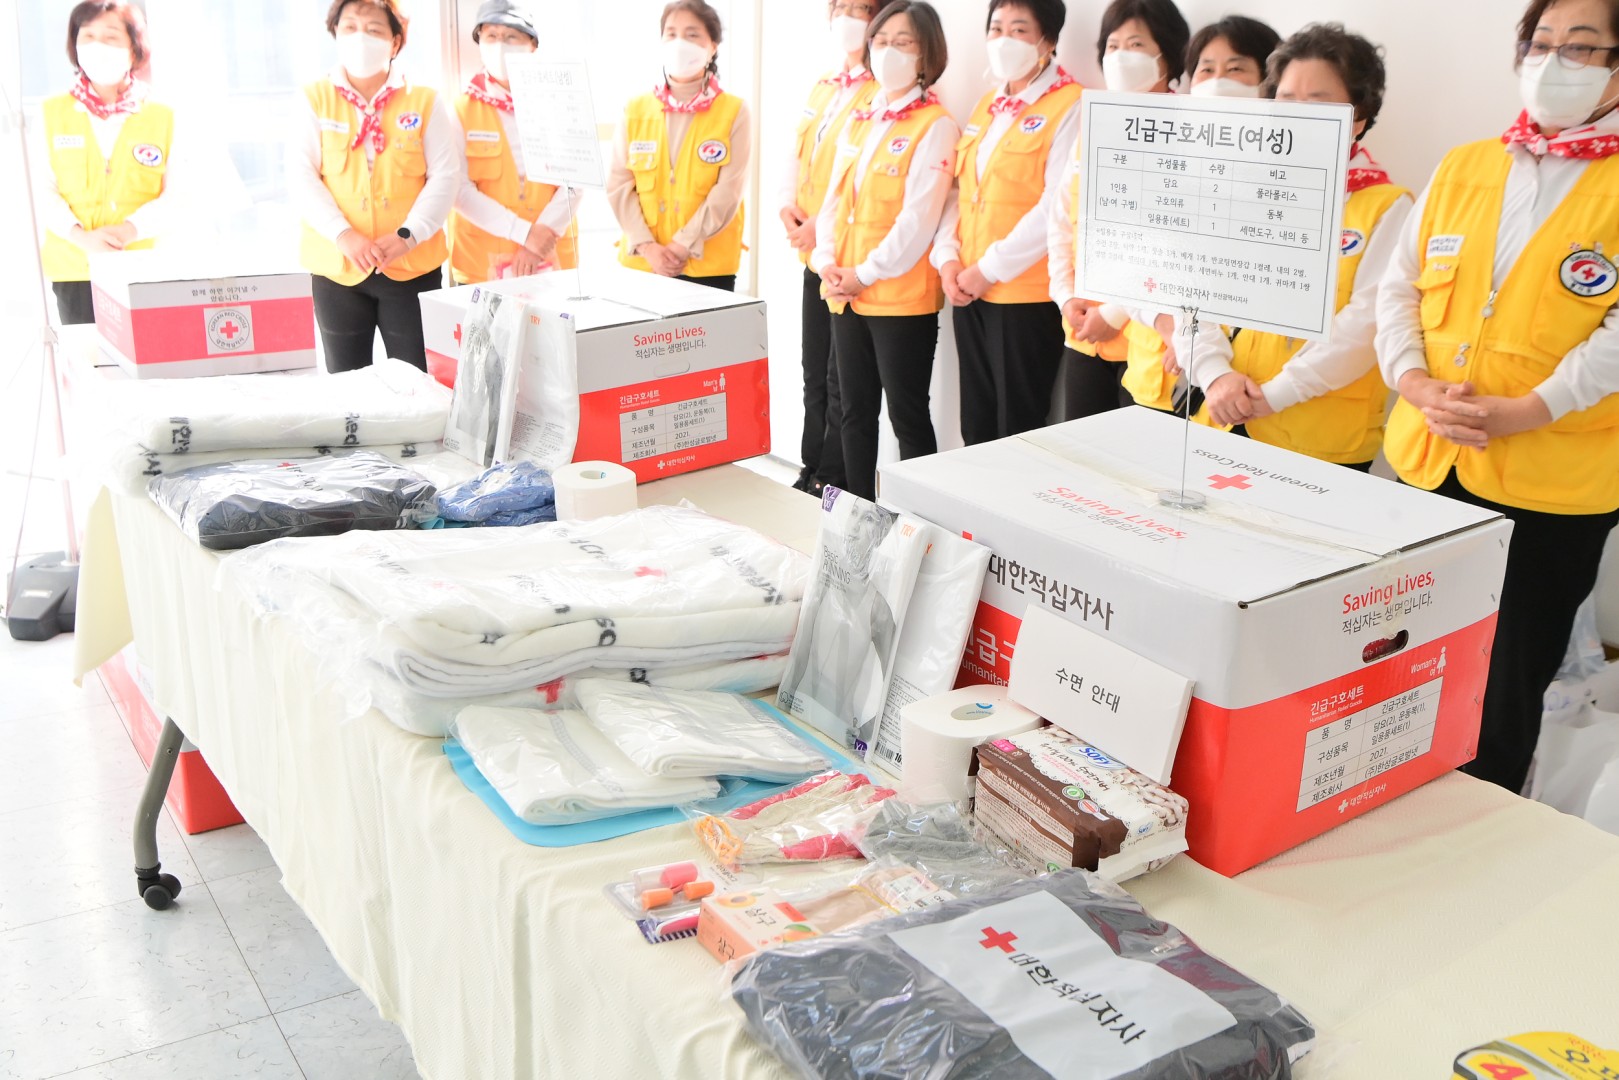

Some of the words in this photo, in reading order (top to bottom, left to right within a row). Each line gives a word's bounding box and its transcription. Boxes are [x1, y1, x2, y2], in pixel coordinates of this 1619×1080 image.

[1124, 117, 1293, 155] 긴급구호세트(여성)
[1113, 153, 1127, 165] 구분
[1156, 158, 1187, 171] 구성물품
[1209, 163, 1226, 175] 수량
[1269, 169, 1287, 180] 비고
[1110, 183, 1128, 194] 1인용
[1163, 178, 1178, 188] 담요
[1213, 184, 1218, 193] 2
[1155, 196, 1184, 208] 구호의류
[1256, 188, 1298, 201] 폴라폴리스
[1121, 199, 1138, 210] 구별)
[1147, 213, 1190, 227] 일용품(세트)
[1267, 209, 1284, 221] 동복
[1239, 226, 1275, 240] 세면도구,
[1279, 230, 1296, 242] 내의
[1300, 233, 1309, 244] 등
[1160, 282, 1210, 301] 대한적십자사
[633, 331, 672, 347] Saving
[675, 326, 706, 340] Lives,
[635, 346, 666, 359] 적십자는
[667, 339, 707, 354] 생명입니다.
[619, 389, 660, 405] 긴급구호세트
[678, 398, 708, 411] 긴급구호세트
[632, 448, 657, 459] 제조회사
[1192, 448, 1234, 467] Cross
[1233, 463, 1266, 479] Red
[1266, 472, 1331, 496] Korean
[1032, 490, 1088, 515] 적십자는
[1048, 486, 1125, 518] Saving
[1127, 513, 1190, 540] Lives,
[901, 524, 917, 537] TRY
[988, 553, 1114, 631] 대한적십자사
[1343, 585, 1393, 615] Saving
[1397, 571, 1435, 596] Lives,
[1342, 611, 1382, 635] 적십자는
[1385, 591, 1432, 621] 생명입니다.
[1410, 657, 1437, 674] Woman's
[1055, 668, 1084, 694] 수면
[1091, 685, 1121, 713] 안대
[1310, 685, 1364, 716] 긴급구호세트
[1382, 690, 1419, 714] 긴급구호세트
[1321, 727, 1330, 740] 품
[1344, 718, 1352, 730] 명
[1318, 742, 1349, 763] 구성품목
[1314, 765, 1345, 787] 제조년월
[1312, 781, 1343, 802] 제조회사
[745, 908, 777, 926] 살구
[1008, 953, 1146, 1045] 대한적십자사
